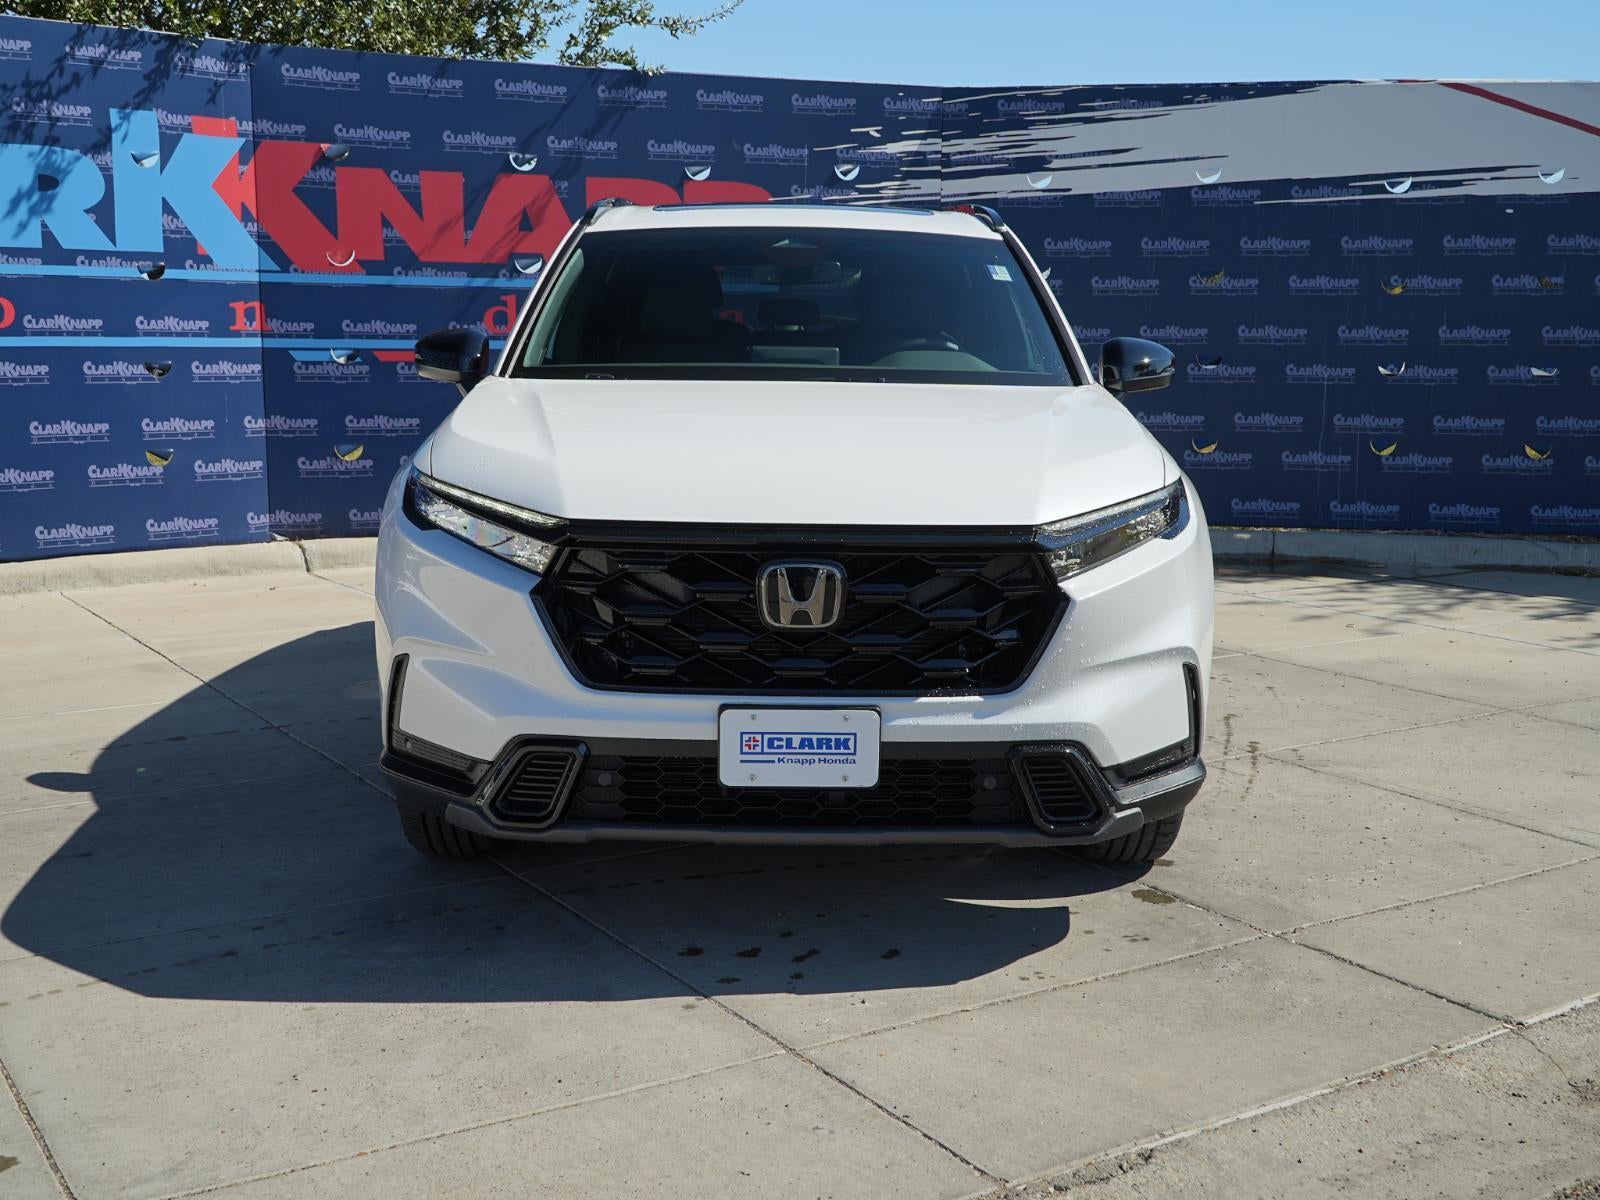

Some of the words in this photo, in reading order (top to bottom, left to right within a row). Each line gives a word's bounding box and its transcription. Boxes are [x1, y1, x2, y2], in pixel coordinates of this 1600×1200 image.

[767, 737, 851, 751] CLARK
[777, 757, 816, 766] Knapp
[818, 757, 857, 765] Honda
